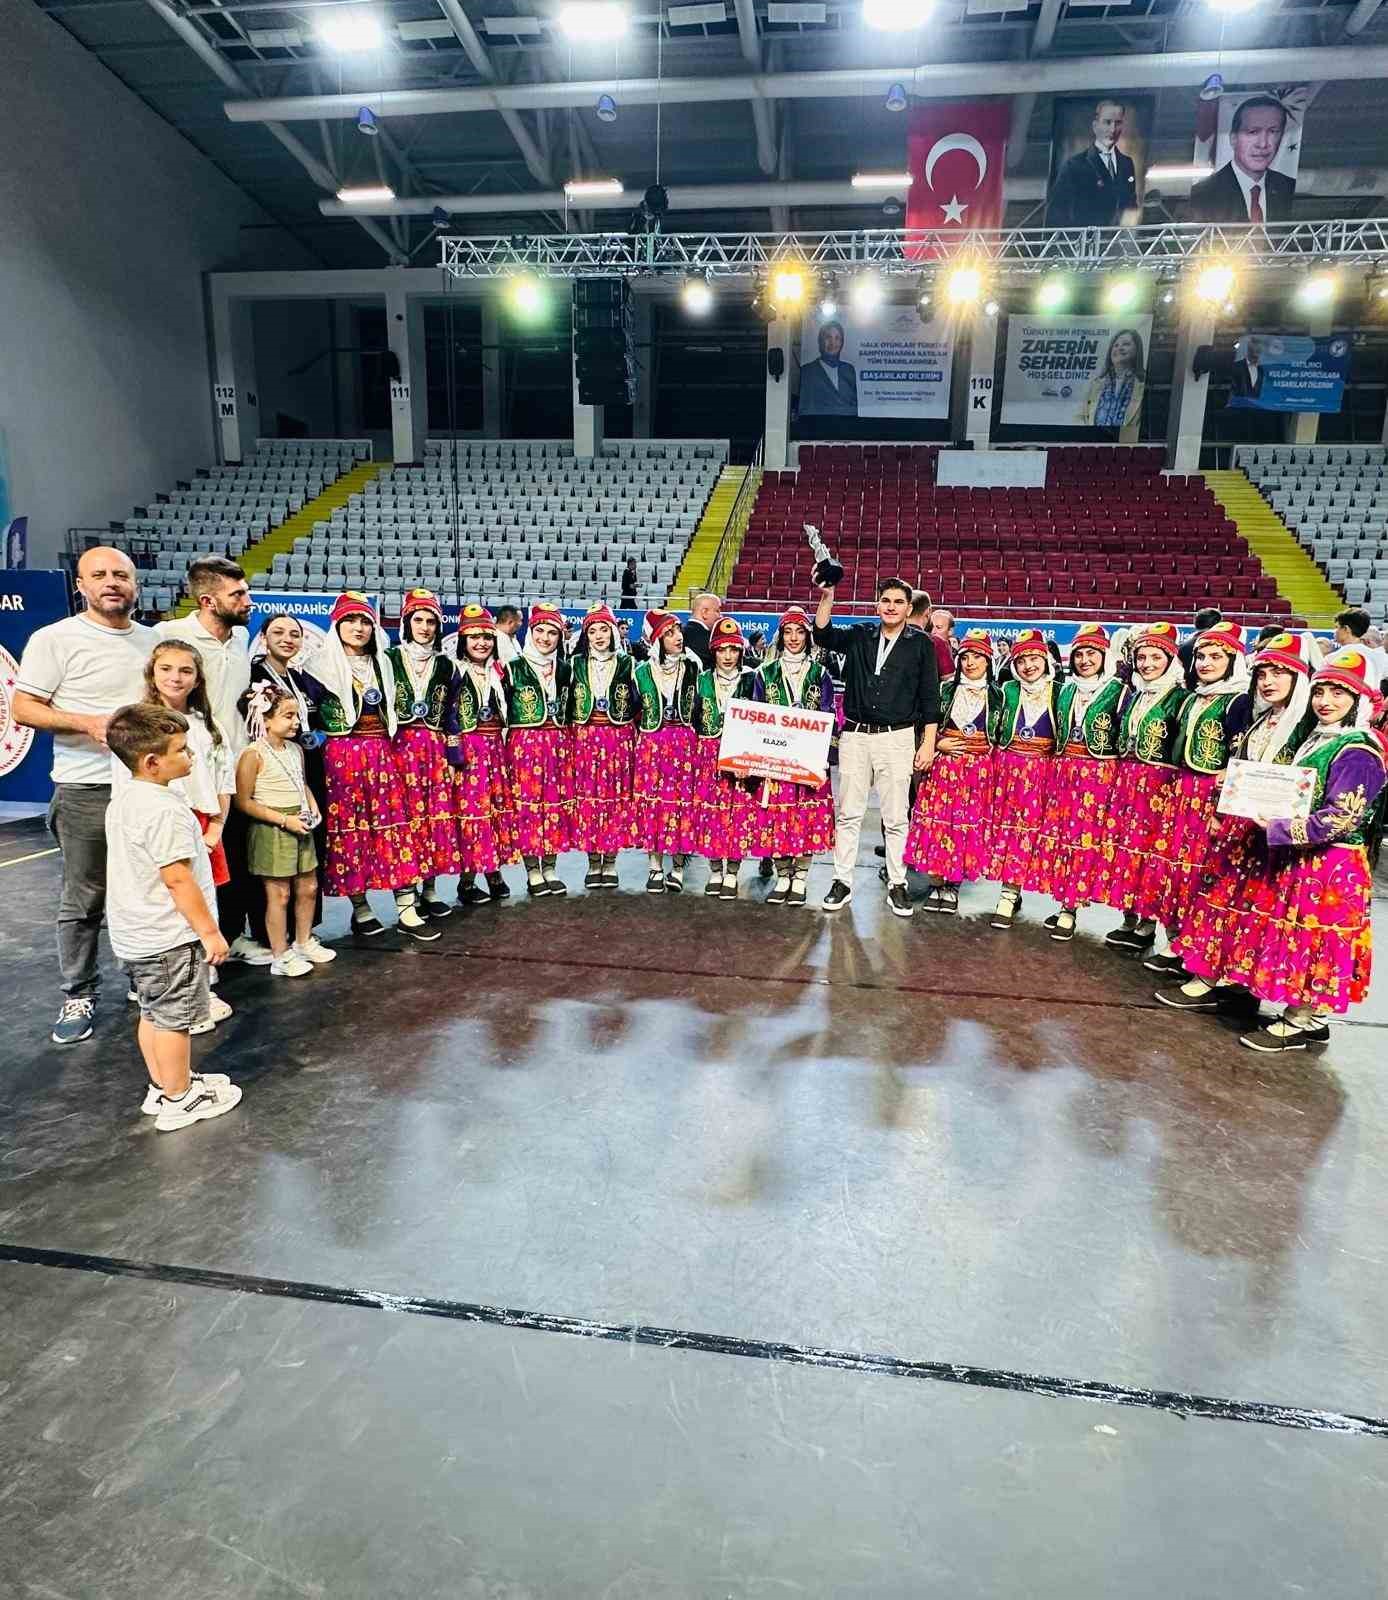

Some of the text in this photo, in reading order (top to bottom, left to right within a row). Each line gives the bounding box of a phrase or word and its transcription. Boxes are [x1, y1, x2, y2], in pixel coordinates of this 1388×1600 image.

[1020, 335, 1098, 354] ZAFERİN
[1018, 352, 1098, 372] ŞEHRİNE
[863, 371, 907, 380] BAŞARILAR
[970, 377, 992, 390] 110
[215, 387, 234, 398] 112
[392, 386, 409, 398] 111
[973, 395, 986, 408] K
[221, 403, 234, 416] M
[0, 594, 25, 611] AR
[730, 706, 830, 733] TUŞBA SANAT
